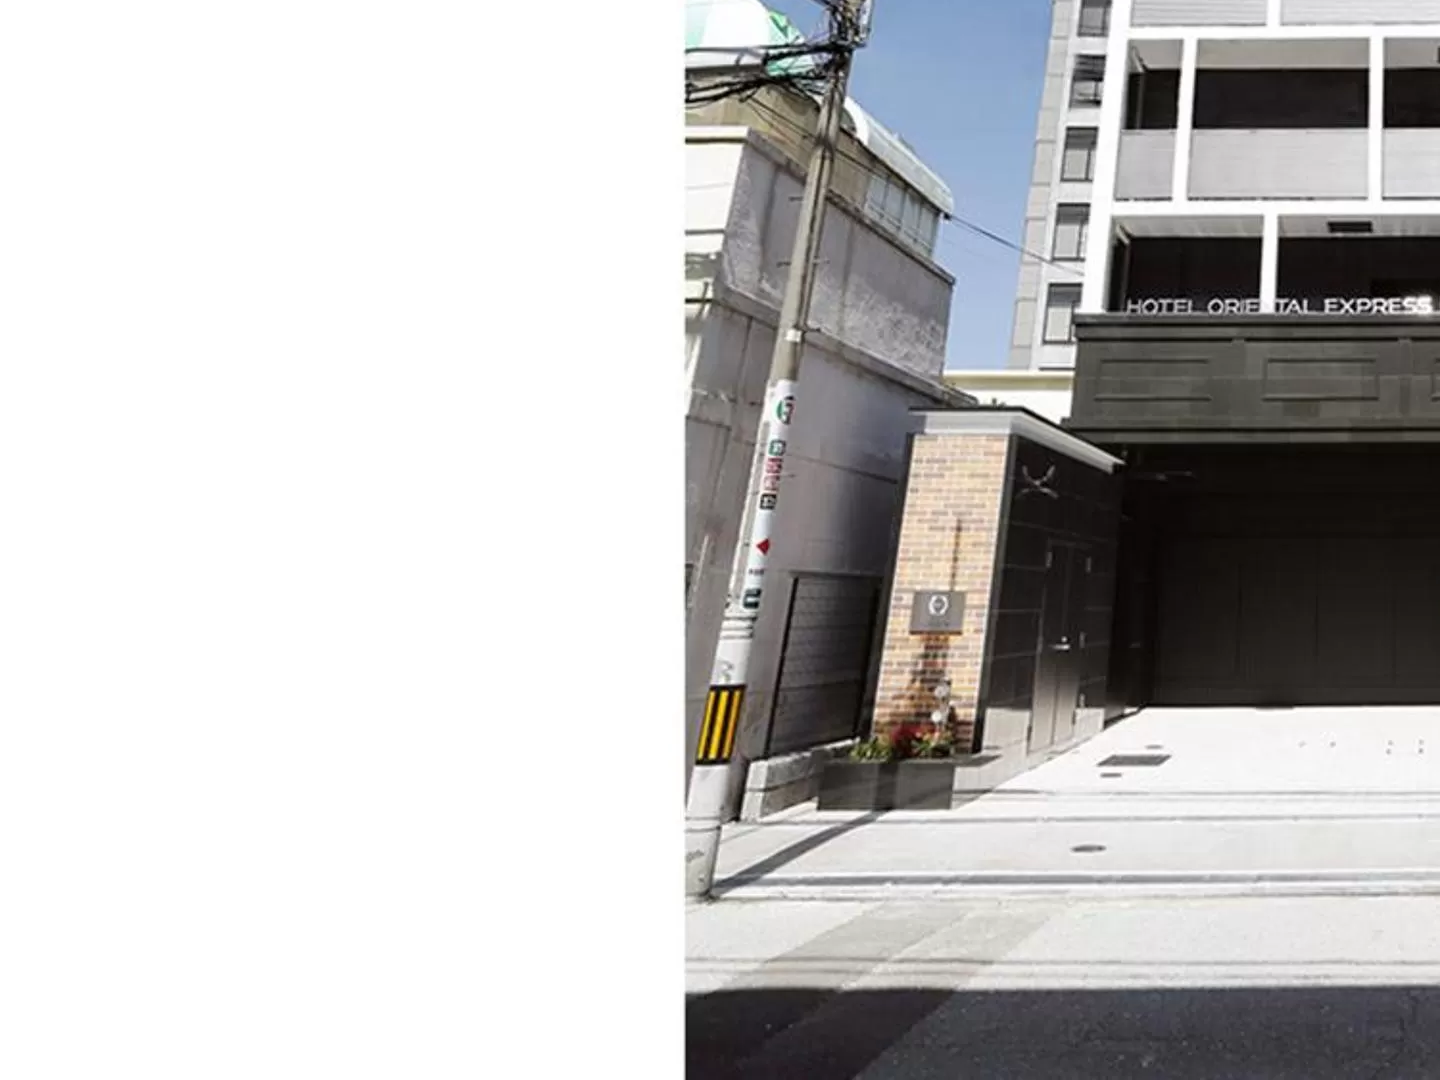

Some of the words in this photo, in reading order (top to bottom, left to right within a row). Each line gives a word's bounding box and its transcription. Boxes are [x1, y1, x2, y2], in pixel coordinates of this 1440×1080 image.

[1126, 298, 1193, 314] HOTEL
[1207, 297, 1310, 314] ORIETAL
[1323, 296, 1433, 315] EXPRESS
